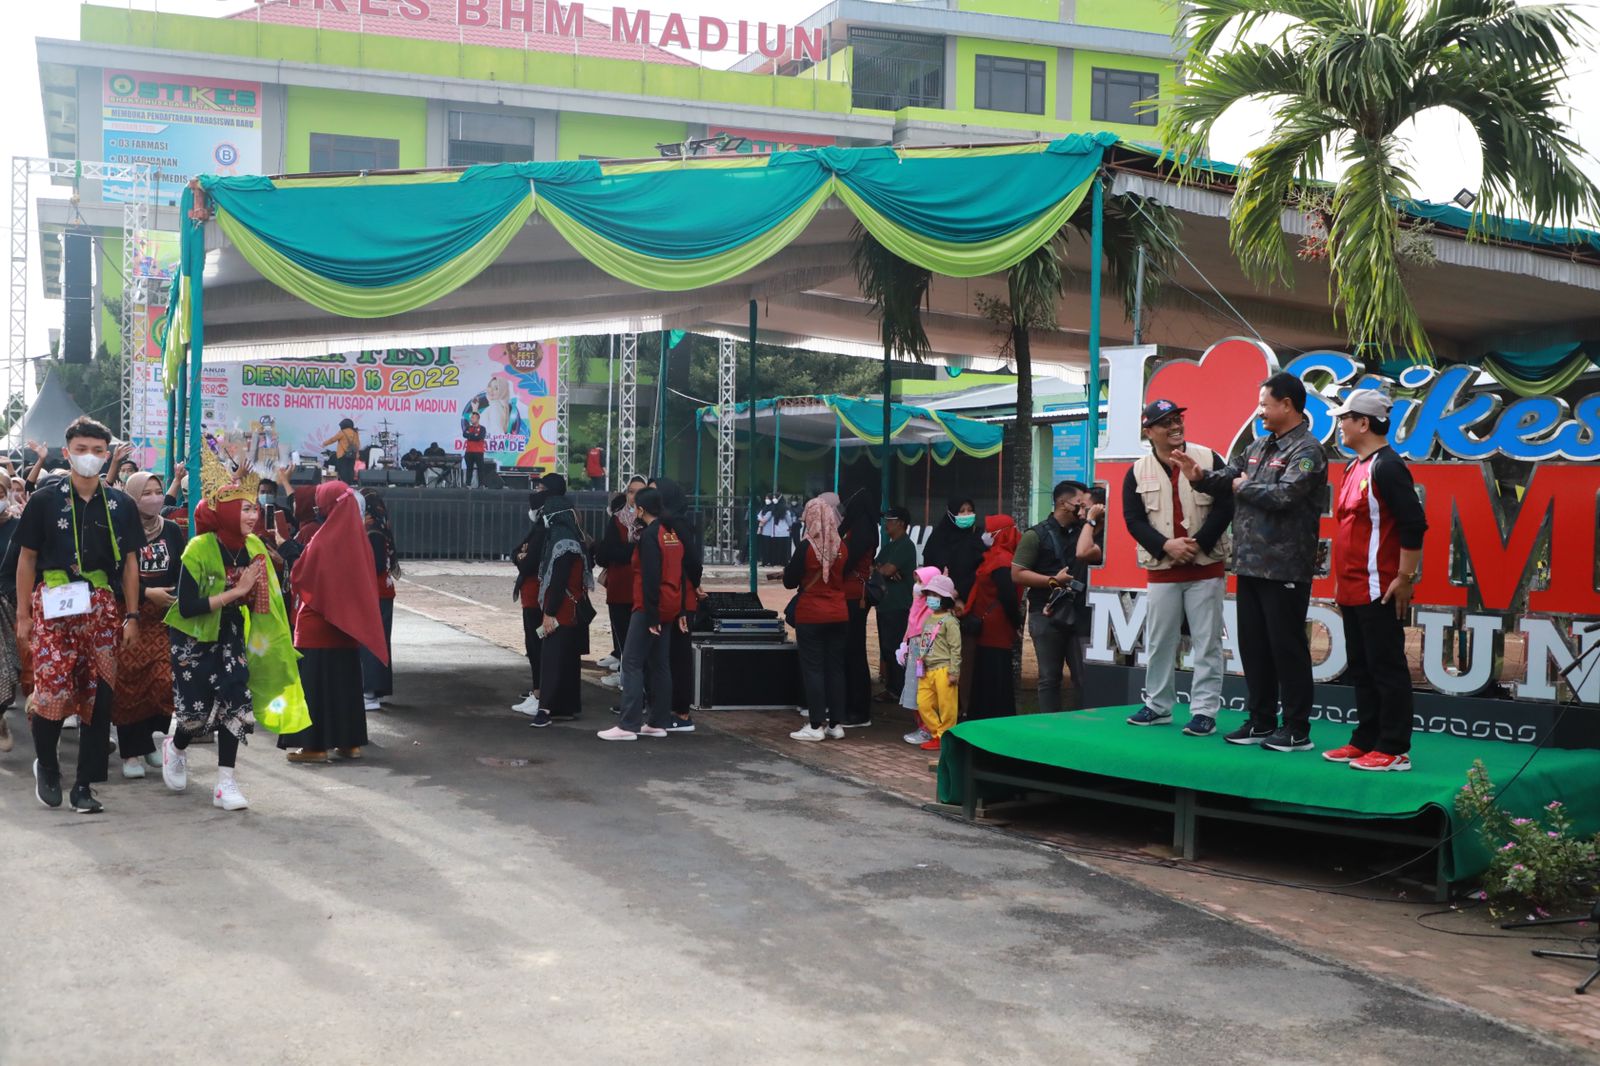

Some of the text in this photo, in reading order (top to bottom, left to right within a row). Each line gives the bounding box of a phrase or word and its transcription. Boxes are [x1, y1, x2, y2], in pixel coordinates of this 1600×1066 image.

[457, 0, 584, 38] BHM
[612, 7, 822, 62] MADIUN
[138, 81, 256, 112] STIKES
[112, 109, 254, 128] MEMBUKA PENDAFTARAN MAHASISWA BARU
[132, 139, 168, 151] FARMASI
[222, 149, 231, 160] B
[162, 173, 188, 184] MEDIS
[516, 359, 535, 368] 2022
[242, 364, 356, 389] DIESNATALIS
[364, 369, 382, 391] 16
[391, 365, 459, 392] 2022
[241, 392, 457, 412] STIKES BHAKTI HUSADA MULIA MADIUN
[1095, 343, 1158, 461] I
[59, 598, 74, 611] 24
